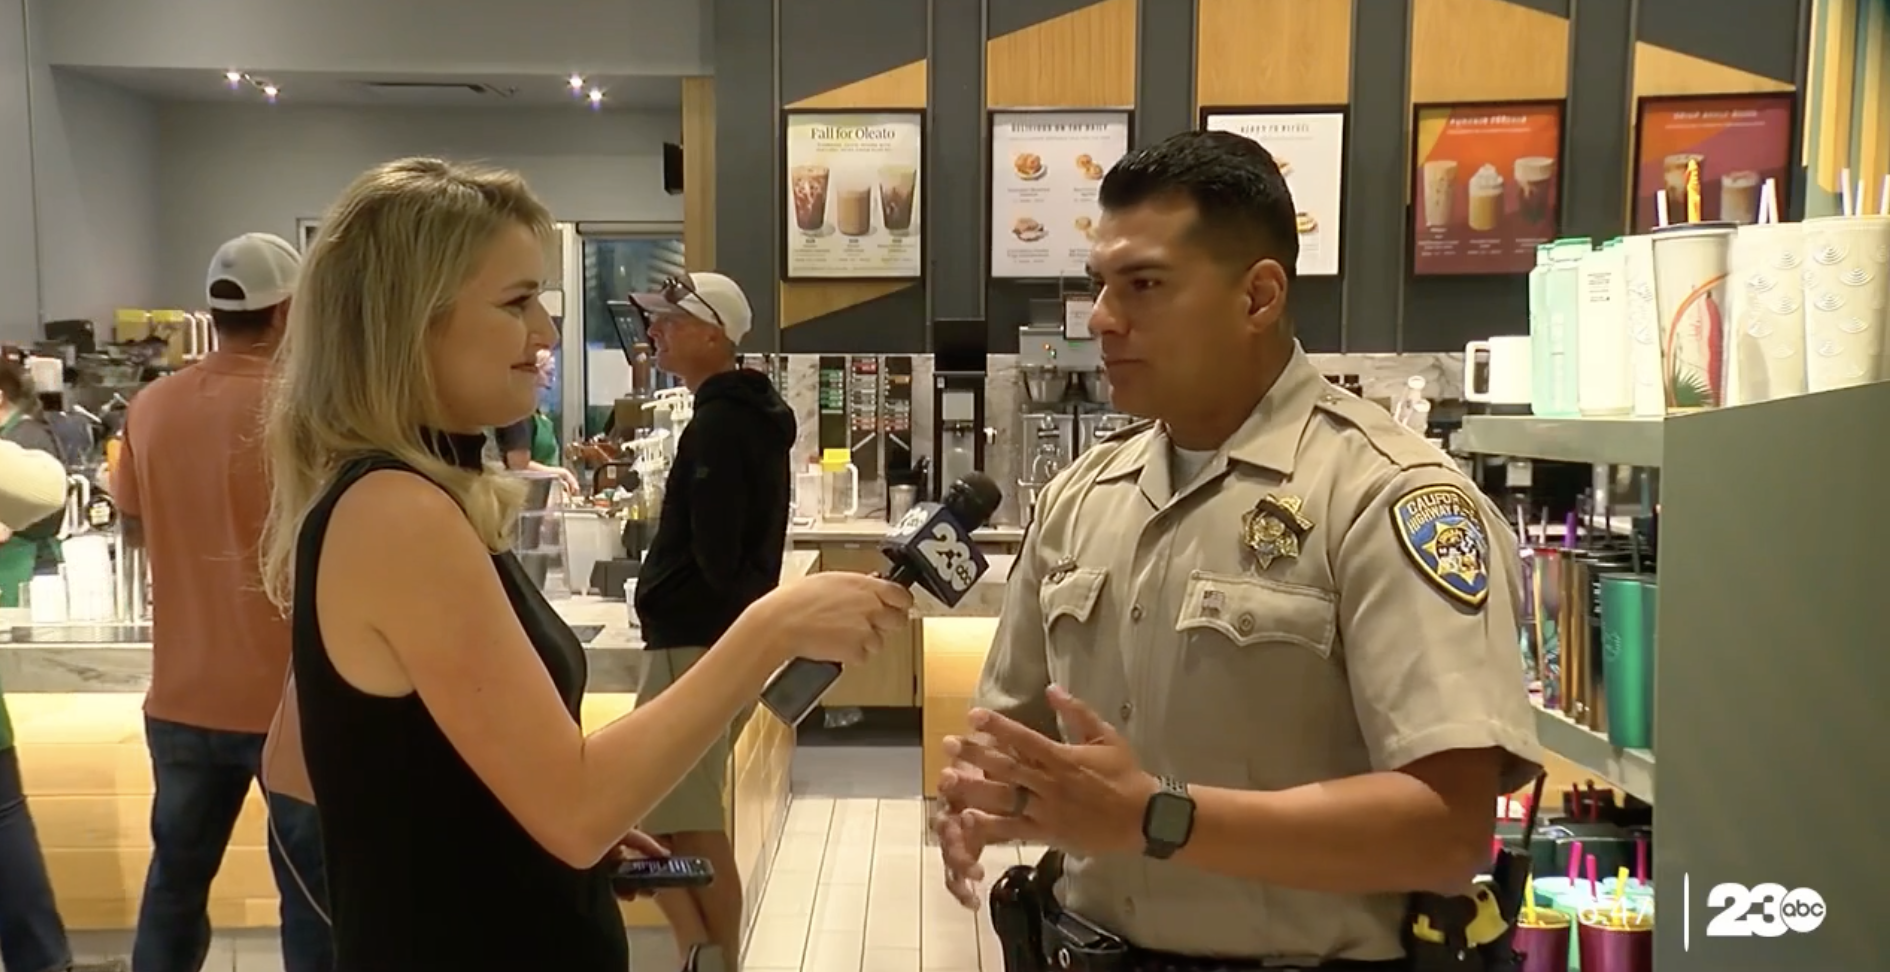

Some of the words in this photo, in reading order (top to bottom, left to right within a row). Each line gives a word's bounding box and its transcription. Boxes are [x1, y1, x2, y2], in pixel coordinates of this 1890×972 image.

[811, 127, 834, 140] Fall
[836, 127, 853, 140] for
[855, 127, 895, 140] Oleato
[1407, 505, 1453, 533] HIGHWAY
